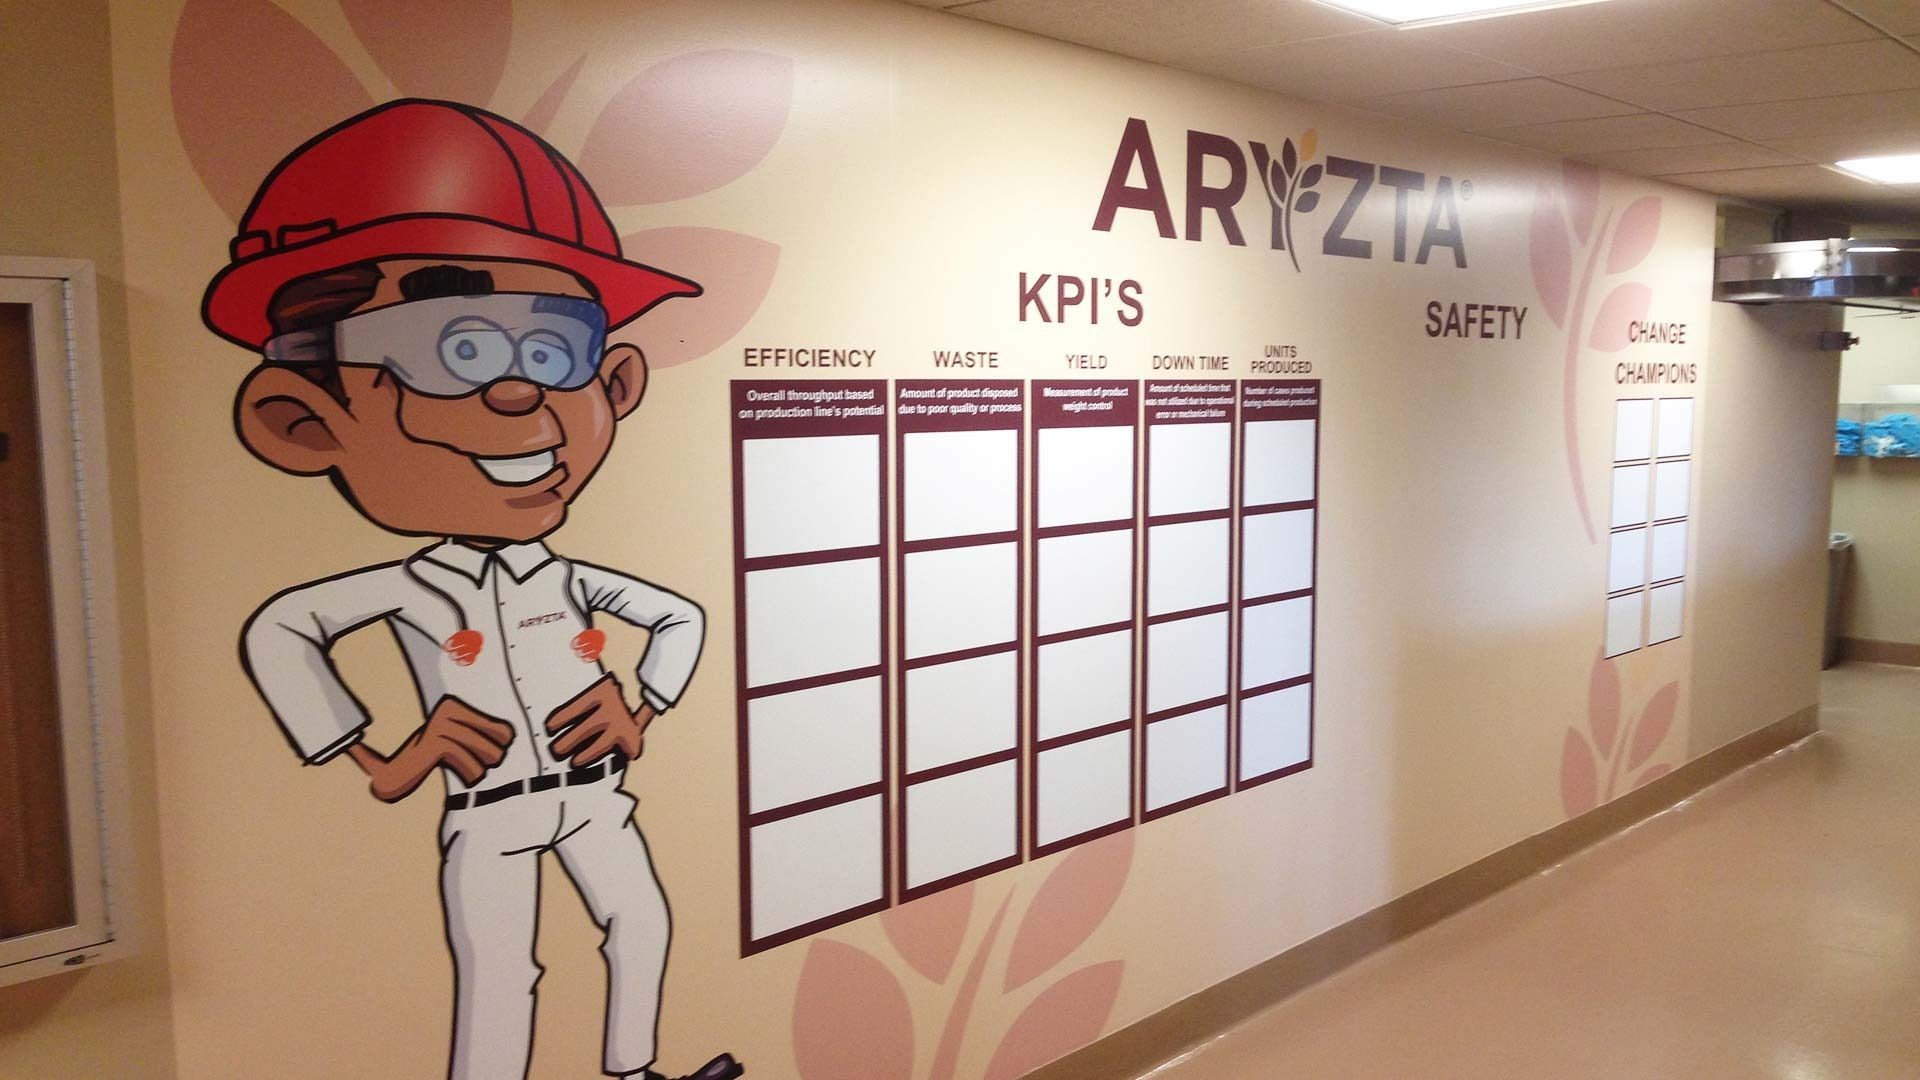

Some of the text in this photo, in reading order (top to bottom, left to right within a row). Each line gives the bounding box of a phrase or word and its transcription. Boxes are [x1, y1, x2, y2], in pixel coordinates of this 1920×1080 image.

[1092, 117, 1468, 270] ARYZTA
[1018, 272, 1144, 327] KPI'S
[1426, 301, 1528, 339] SAFETY
[1629, 321, 1686, 344] CHANGE
[744, 348, 877, 368] EFFICIENCY
[933, 351, 999, 368] WASTE
[1264, 345, 1297, 358] UNITS
[1065, 354, 1108, 369] YIELD
[1152, 355, 1229, 371] DOWN TIME
[1251, 360, 1313, 374] PRODUCED
[1616, 362, 1698, 384] CHAMPIONS
[746, 389, 875, 403] Overall throughput based
[899, 388, 1018, 400] Amount of product disposed
[1043, 387, 1092, 397] Measurement
[1101, 387, 1128, 398] product
[738, 404, 884, 421] on production line's potential
[898, 403, 1022, 416] due to poor quality or process
